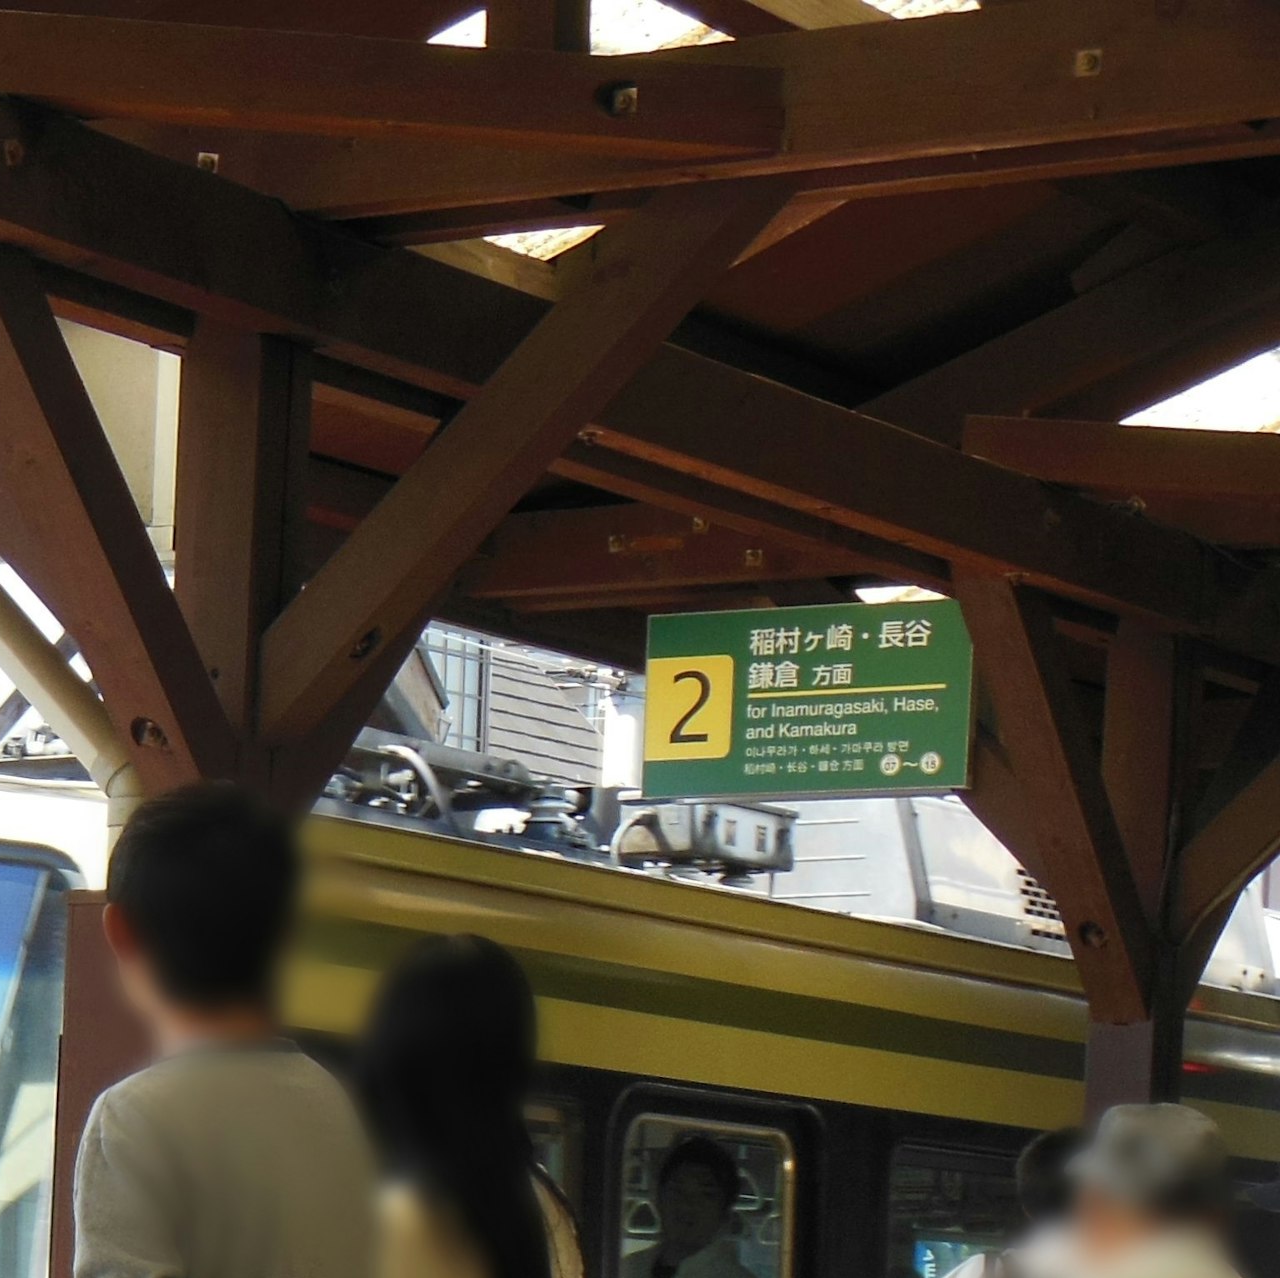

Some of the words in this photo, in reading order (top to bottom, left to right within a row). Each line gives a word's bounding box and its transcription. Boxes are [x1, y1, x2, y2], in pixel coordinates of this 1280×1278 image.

[748, 660, 800, 690] 鎌倉
[811, 663, 853, 687] 方面
[669, 670, 711, 745] 2
[746, 703, 767, 719] for
[771, 698, 889, 718] Inamuragasaki,
[893, 697, 940, 713] Hase,
[745, 724, 775, 740] and
[779, 721, 858, 738] Kamakura
